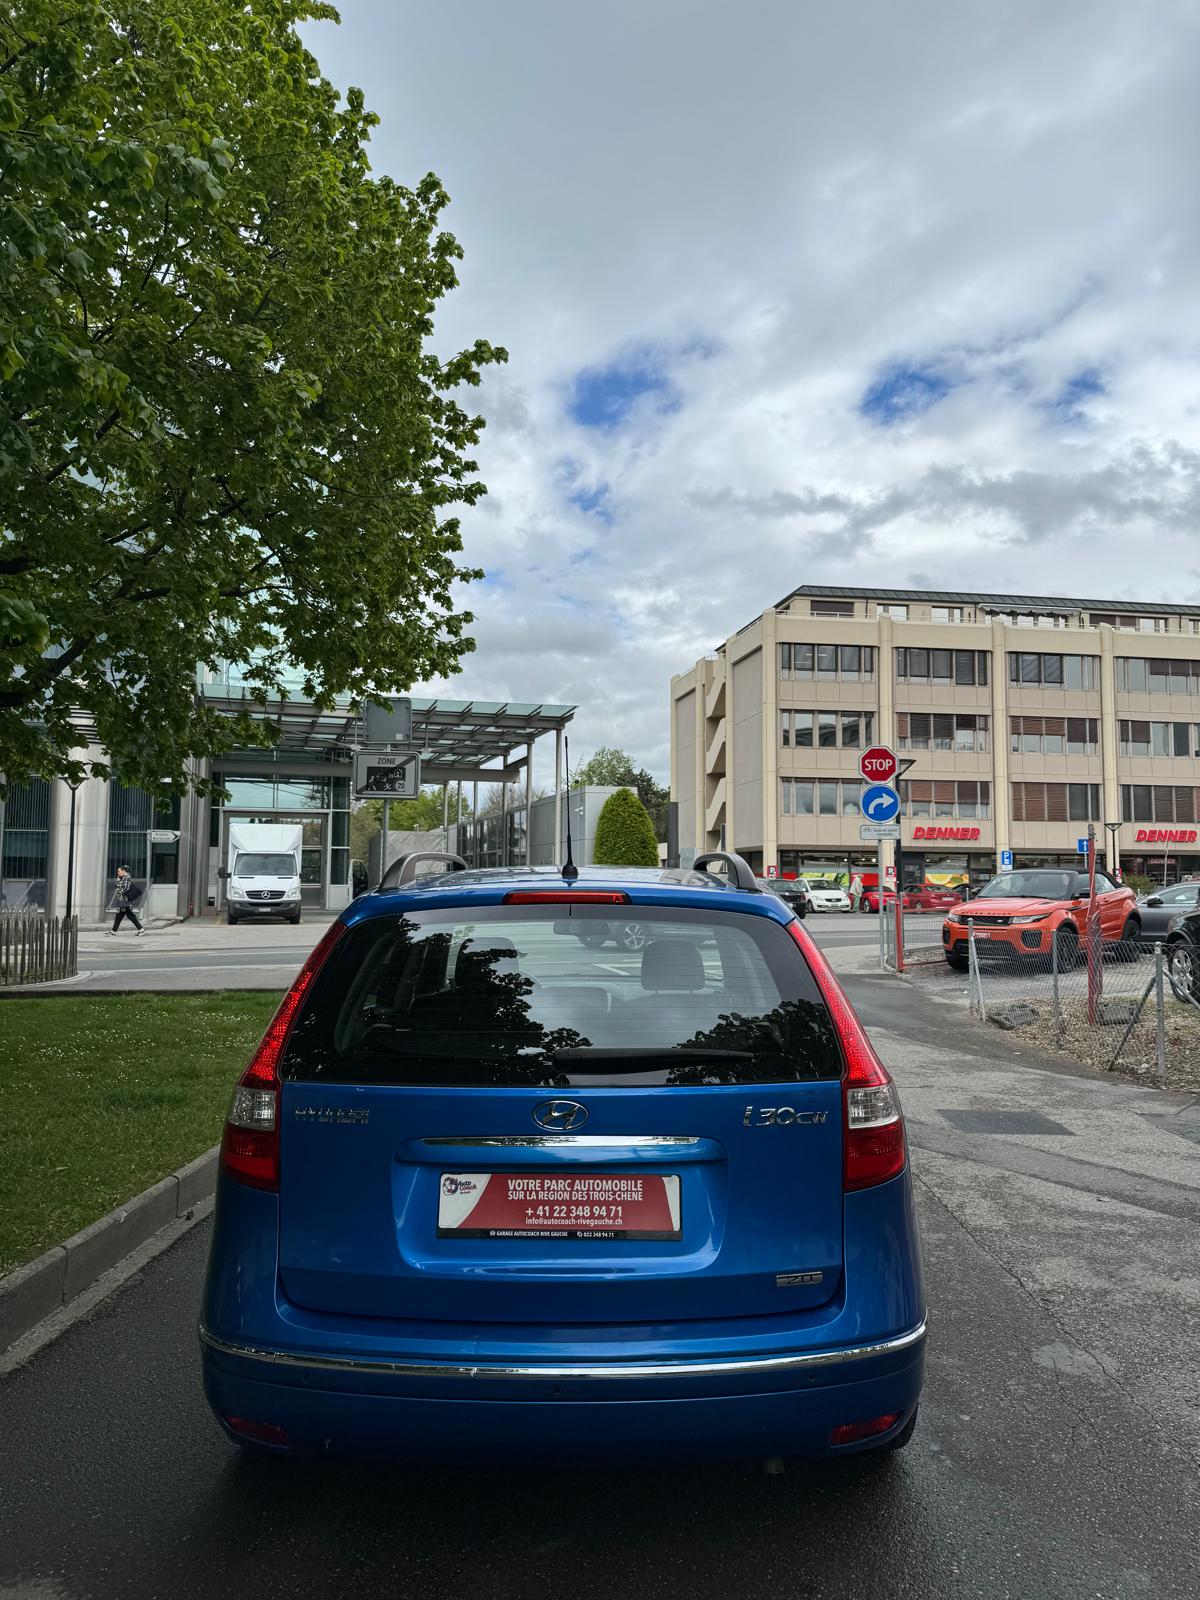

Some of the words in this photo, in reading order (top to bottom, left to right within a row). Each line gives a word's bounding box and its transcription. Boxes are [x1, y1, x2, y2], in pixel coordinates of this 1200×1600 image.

[377, 757, 397, 765] ZONE
[865, 759, 893, 771] STOP
[397, 782, 406, 790] 20
[912, 826, 981, 841] DENNER
[1135, 829, 1198, 842] DENNER
[508, 1179, 542, 1191] VOTRE
[544, 1179, 572, 1191] PARC
[574, 1179, 643, 1191] AUTOMOBILE
[508, 1191, 525, 1200] SUR
[526, 1191, 537, 1200] LA
[539, 1191, 571, 1200] REGION
[572, 1191, 587, 1201] DES
[588, 1191, 643, 1201] TROIS-CHENE
[525, 1207, 534, 1217] +
[536, 1206, 550, 1217] 41
[553, 1206, 567, 1217] 22
[569, 1206, 591, 1217] 348
[593, 1206, 607, 1217] 94
[609, 1206, 623, 1217] 71
[525, 1217, 623, 1227] info@autocoach-rivegauche.ch
